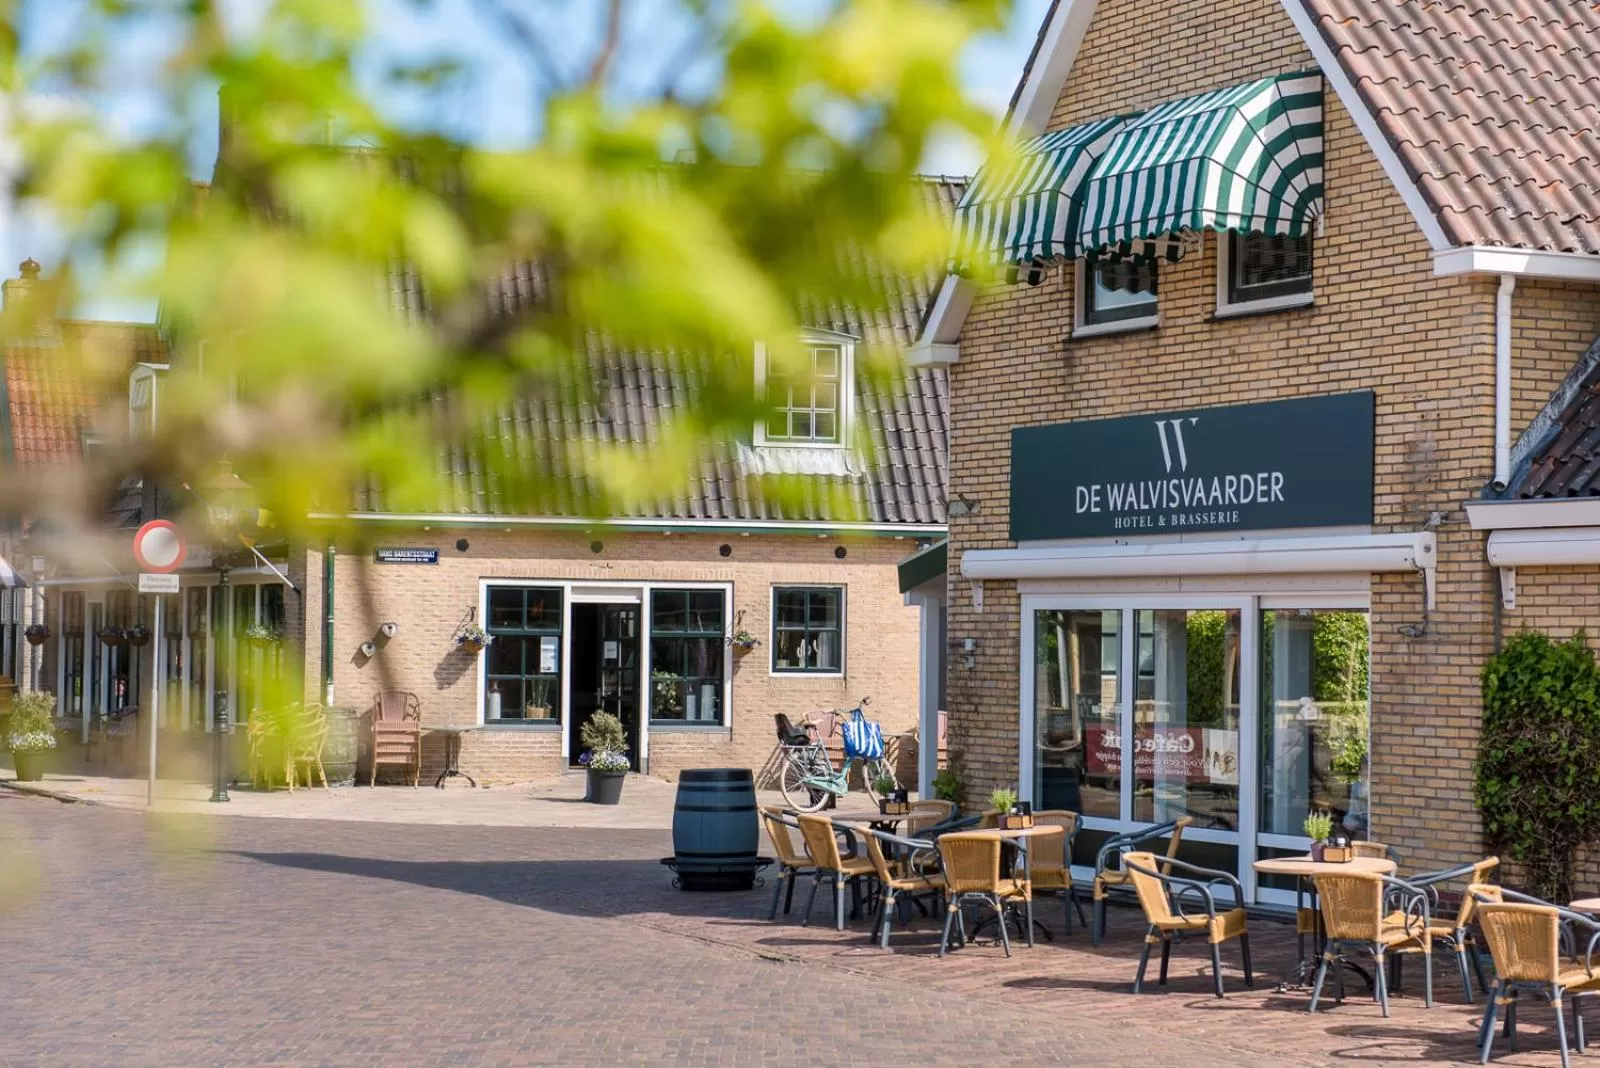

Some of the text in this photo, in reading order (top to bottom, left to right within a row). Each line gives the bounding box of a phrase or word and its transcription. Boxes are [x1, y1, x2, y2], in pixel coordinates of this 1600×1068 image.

[1076, 472, 1284, 513] DE WALVISVAARDER
[1114, 511, 1240, 529] HOTEL & BRASSERIE
